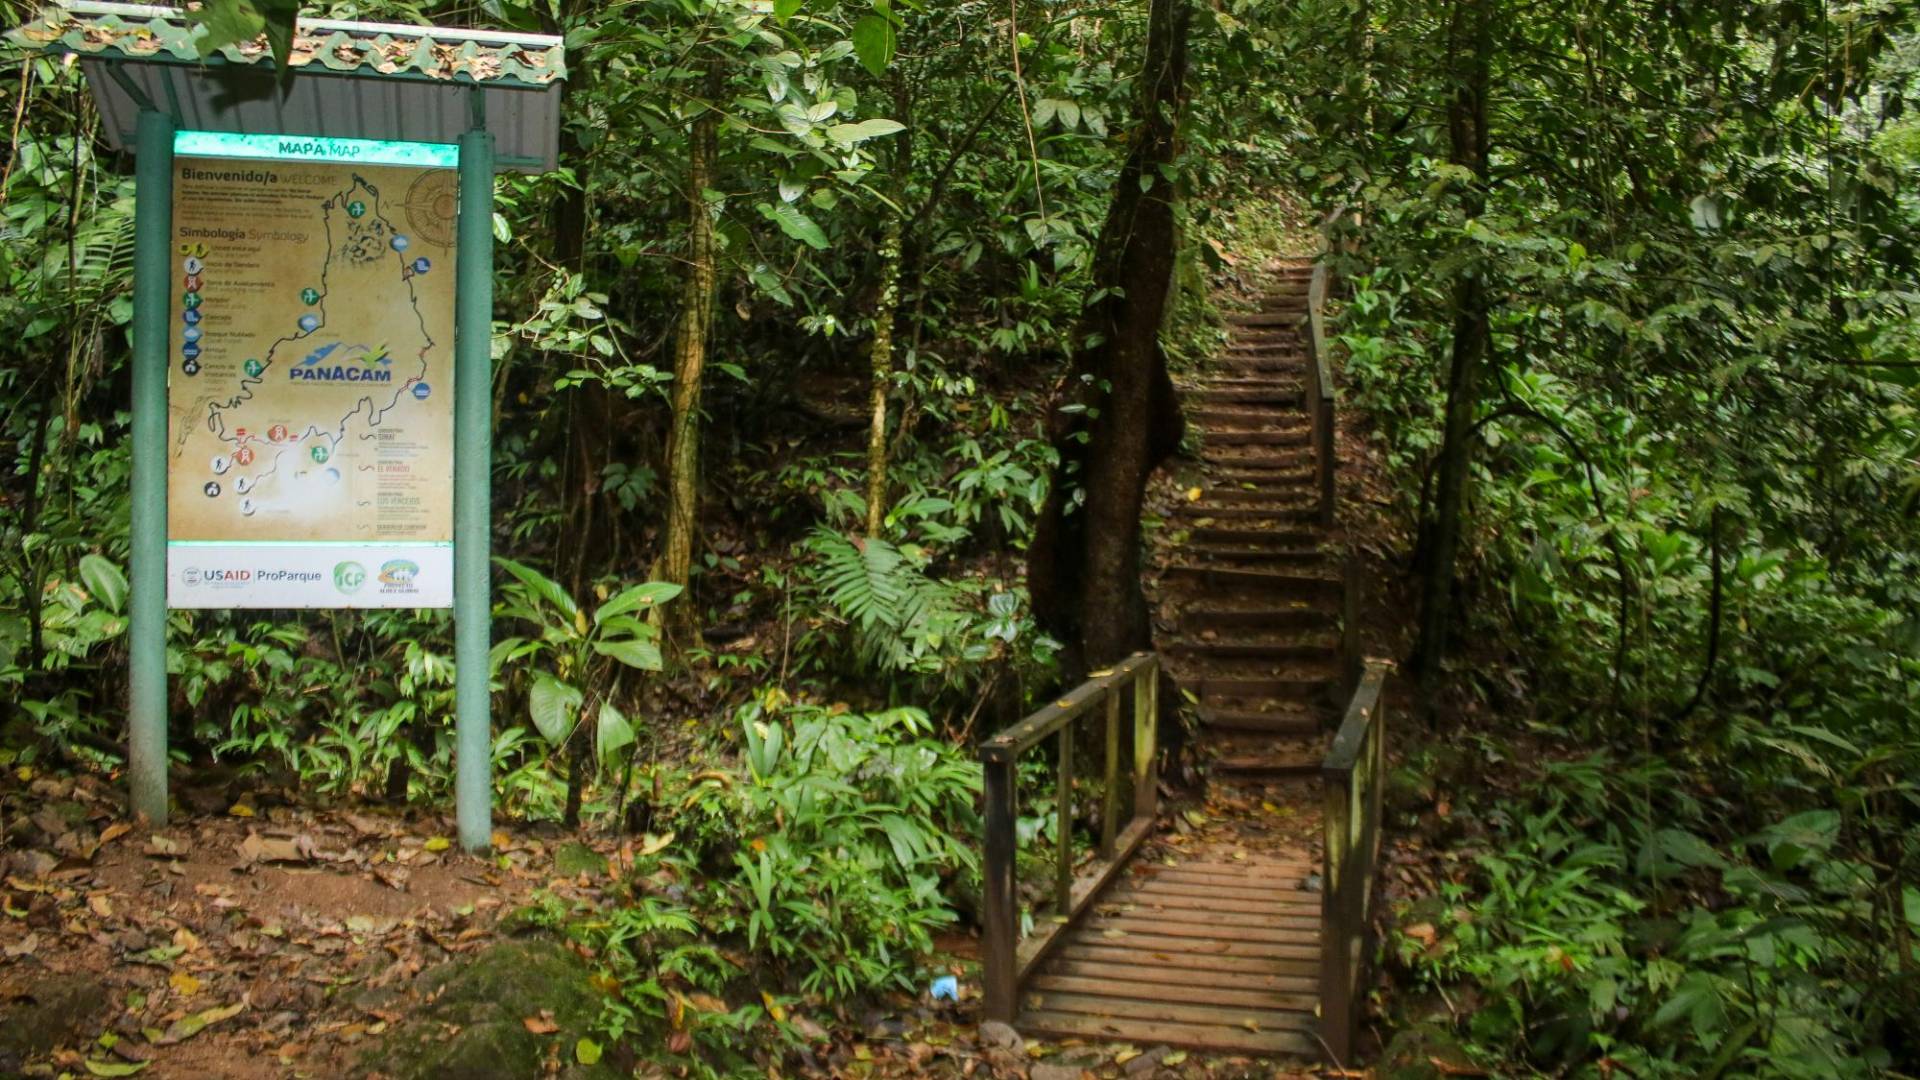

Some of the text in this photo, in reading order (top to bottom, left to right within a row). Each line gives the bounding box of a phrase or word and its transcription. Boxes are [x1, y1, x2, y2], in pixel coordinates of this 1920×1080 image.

[278, 141, 360, 157] MAPA MAP
[182, 167, 338, 186] Bienvenido/a WELCOME
[249, 228, 310, 244] Symbology
[290, 366, 391, 382] PANACAM
[203, 570, 251, 581] USAID
[257, 570, 322, 583] ProParque
